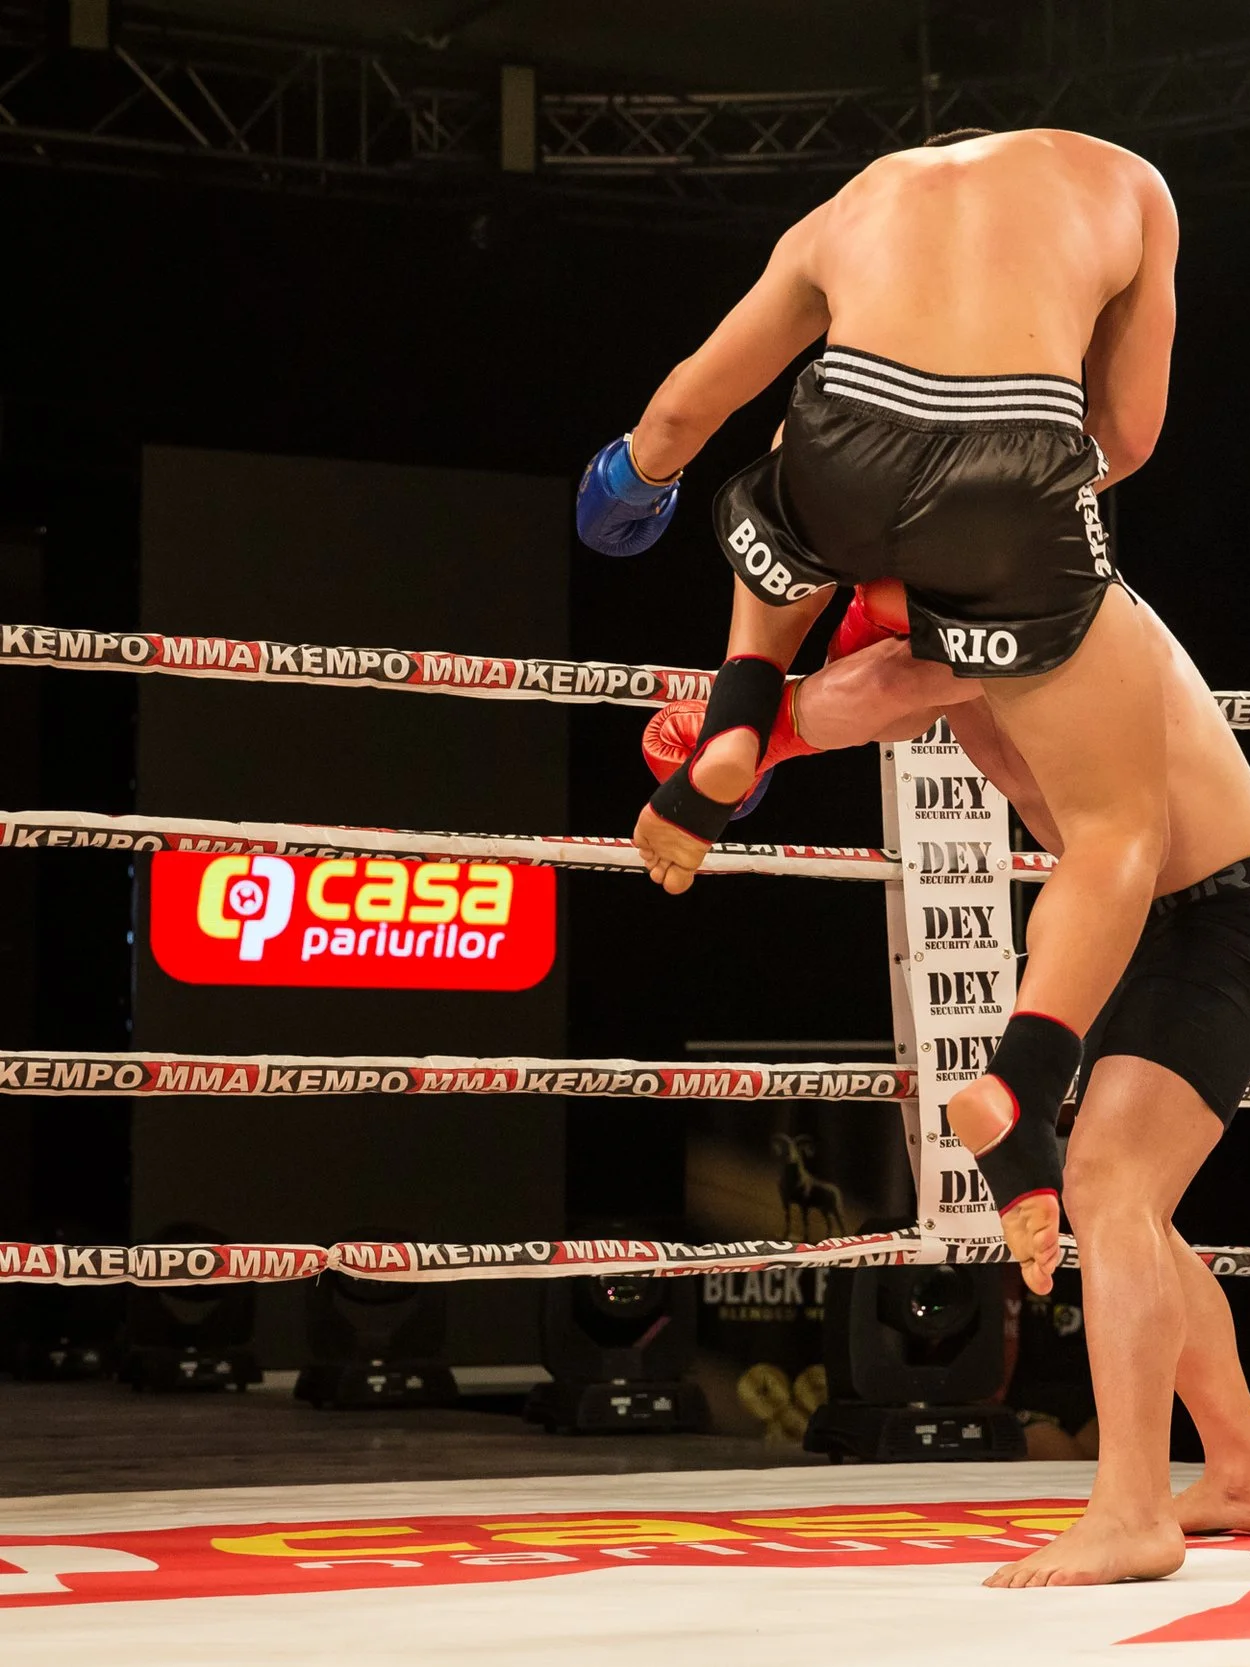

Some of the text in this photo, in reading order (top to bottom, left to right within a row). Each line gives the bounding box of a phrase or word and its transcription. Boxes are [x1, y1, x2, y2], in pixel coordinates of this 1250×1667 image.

[728, 518, 837, 600] BOBO
[2, 625, 712, 700] KEMPO MMA KEMPO MMA KEMPO MM
[938, 628, 1017, 665] RIO
[911, 745, 960, 755] SECURITY
[914, 776, 989, 809] DEY
[914, 810, 991, 820] SECURITY ARAD
[15, 828, 164, 851] KEMPO
[917, 841, 992, 874] DEY
[306, 859, 514, 926] casa
[919, 875, 994, 885] SECURITY ARAD
[922, 905, 995, 940] DEY
[301, 921, 505, 962] pariurilor
[925, 939, 999, 950] SECURITY ARAD
[927, 970, 1000, 1005] DEY
[930, 1004, 1003, 1016] SECURITY ARAD
[934, 1036, 1003, 1071] DEY
[0, 1060, 143, 1091] KEMPO
[156, 1065, 250, 1093] MMA
[265, 1068, 409, 1093] KEMPO
[420, 1070, 508, 1093] MMA
[527, 1071, 660, 1095] KEMPO
[669, 1072, 755, 1097] MMA
[771, 1073, 897, 1097] KEMPO
[936, 1070, 978, 1082] SECURITY
[939, 1169, 989, 1204] DE
[938, 1203, 987, 1214] SECURITY
[0, 1246, 51, 1273] MA
[68, 1249, 216, 1278] KEMPO
[229, 1249, 320, 1277] MMA
[345, 1243, 408, 1269] MA
[417, 1240, 551, 1266] KEMPO
[562, 1239, 654, 1260] MMA
[703, 1267, 804, 1305] BLACK
